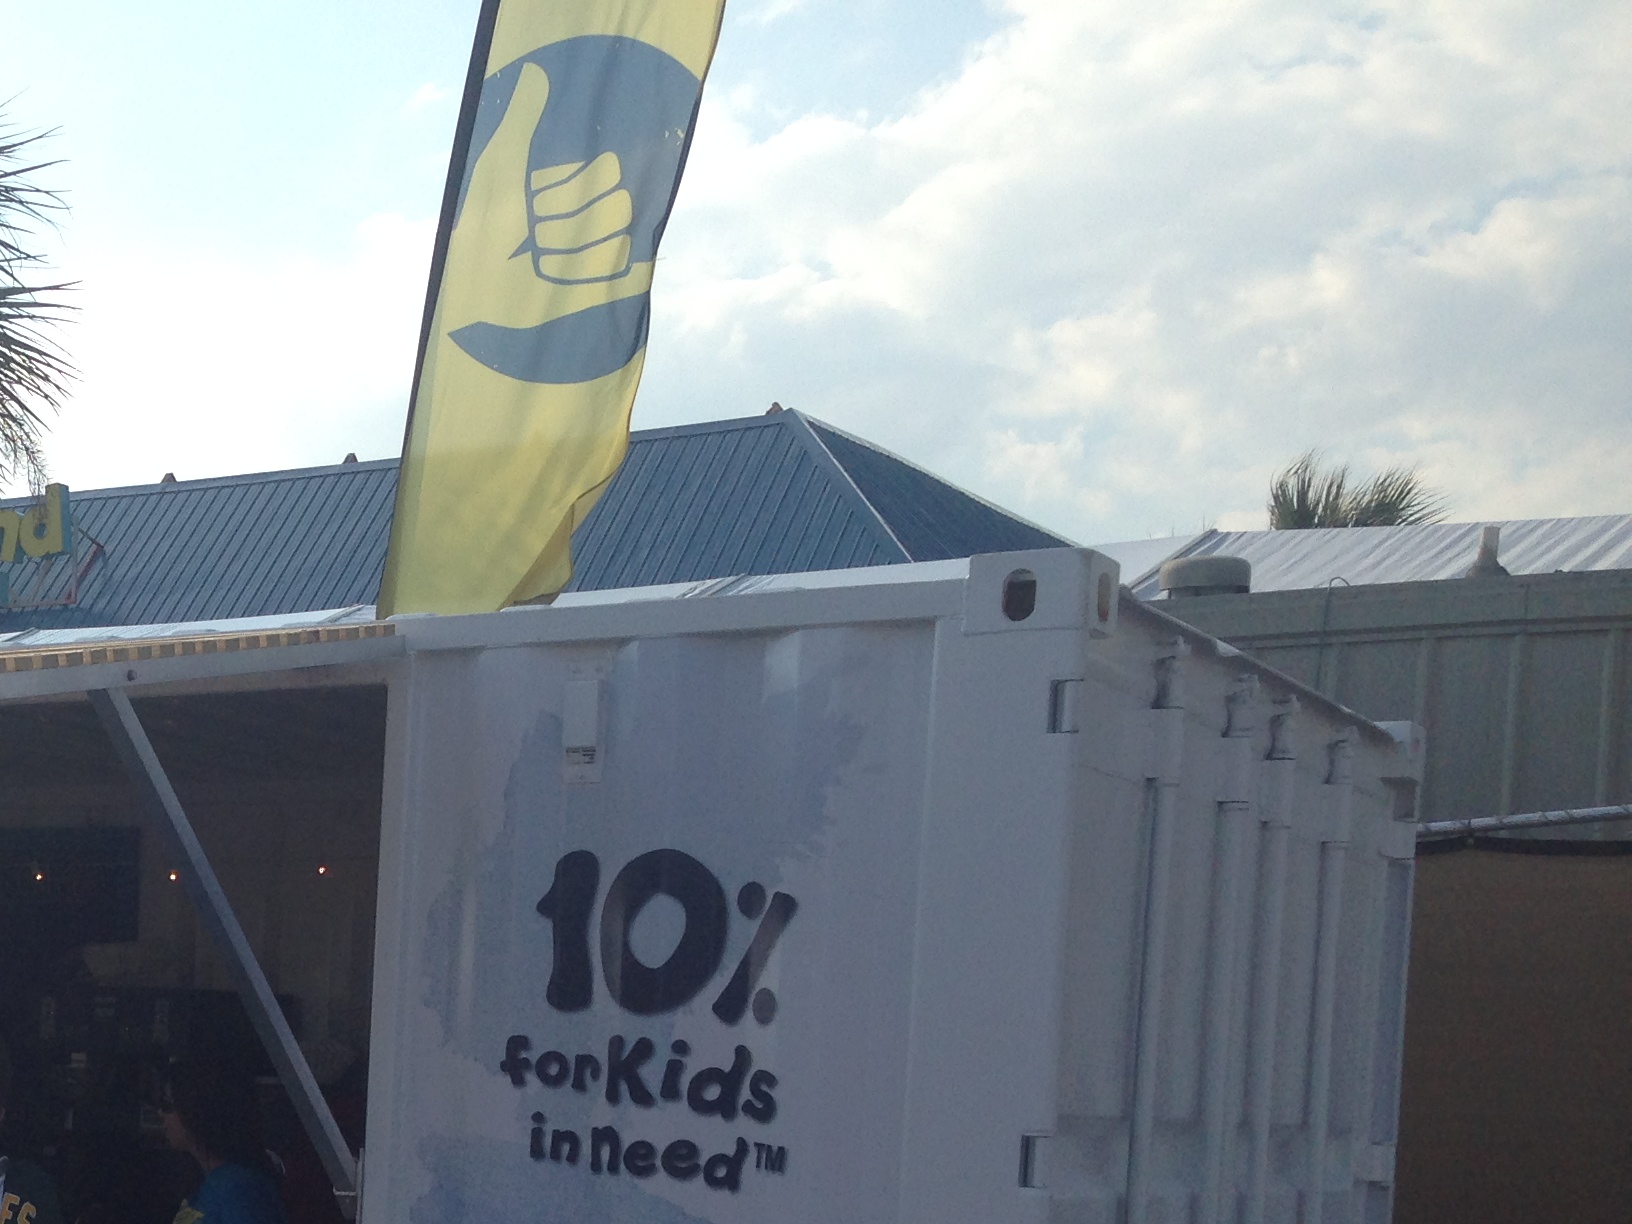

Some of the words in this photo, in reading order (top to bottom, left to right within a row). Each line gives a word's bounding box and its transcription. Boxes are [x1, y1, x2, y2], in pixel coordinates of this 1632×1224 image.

[536, 848, 799, 1027] 10%
[500, 1034, 602, 1092] for
[605, 1034, 779, 1124] Kids
[529, 1110, 582, 1165] in
